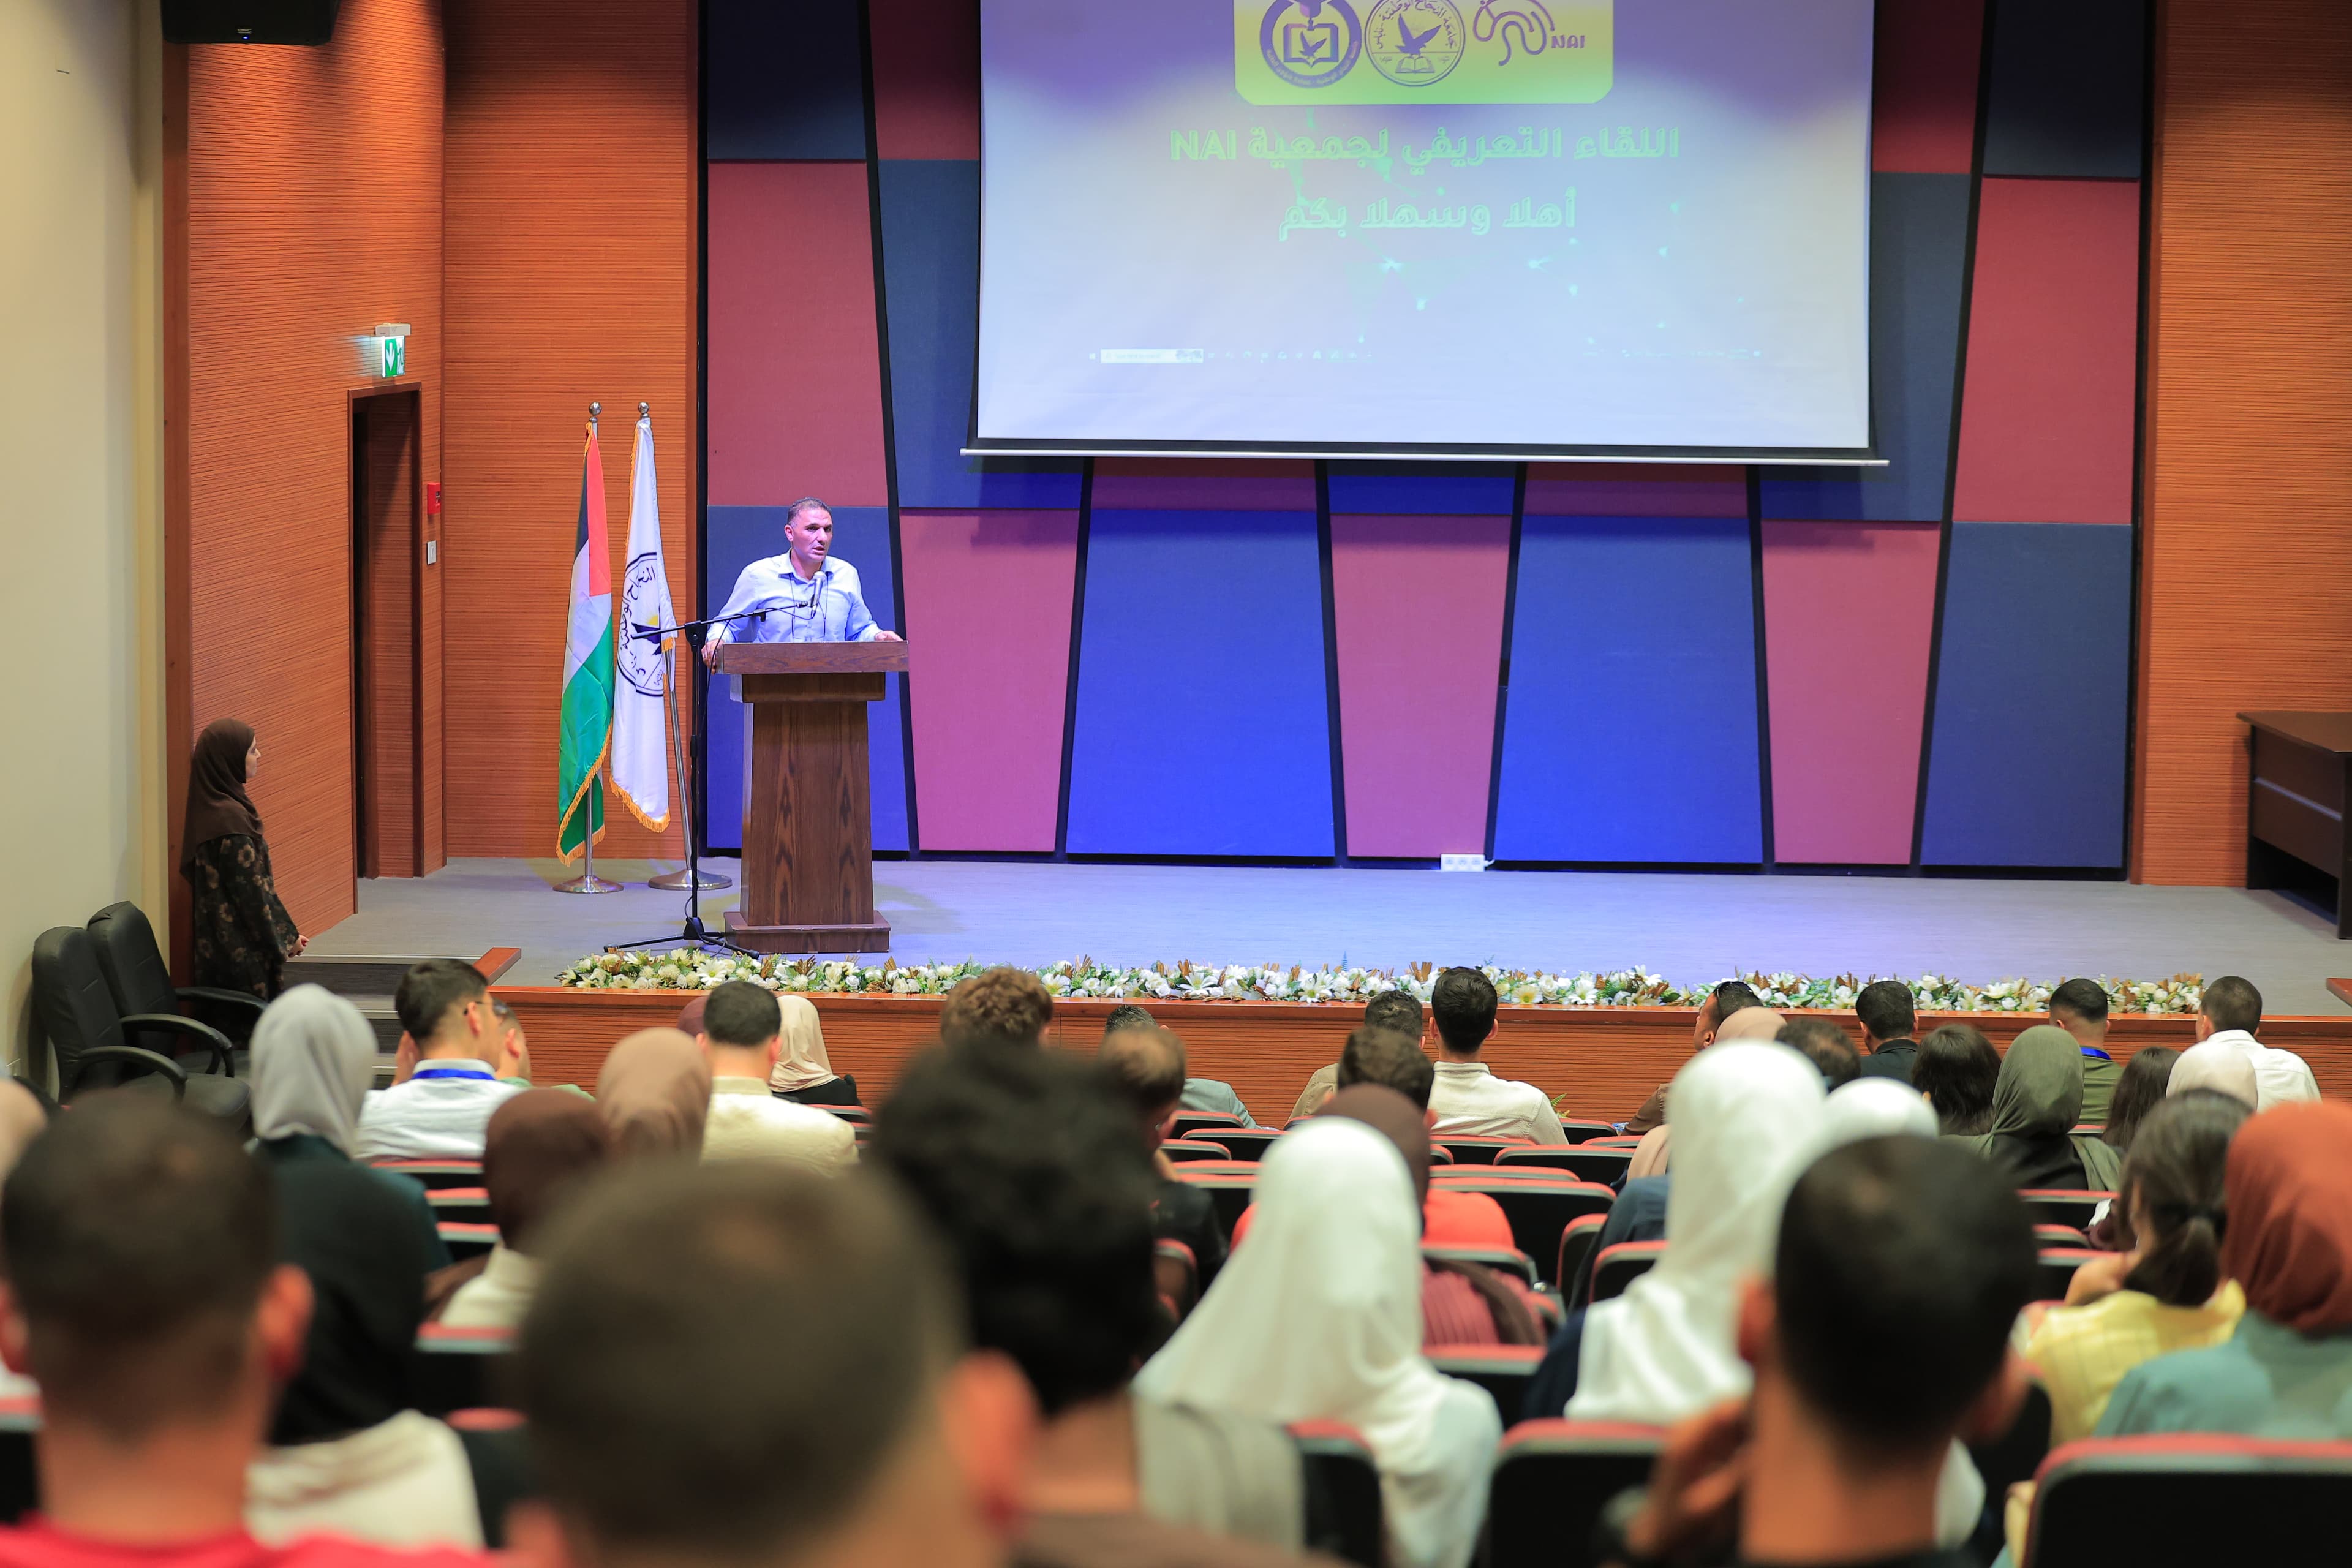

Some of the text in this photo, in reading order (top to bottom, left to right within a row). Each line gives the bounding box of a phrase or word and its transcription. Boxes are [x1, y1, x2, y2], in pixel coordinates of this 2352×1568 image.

[1551, 35, 1585, 48] NAI
[1170, 126, 1680, 176] اللقاء التعريفي لجمعية NAI
[1278, 186, 1578, 241] أهلا وسهلا بكم
